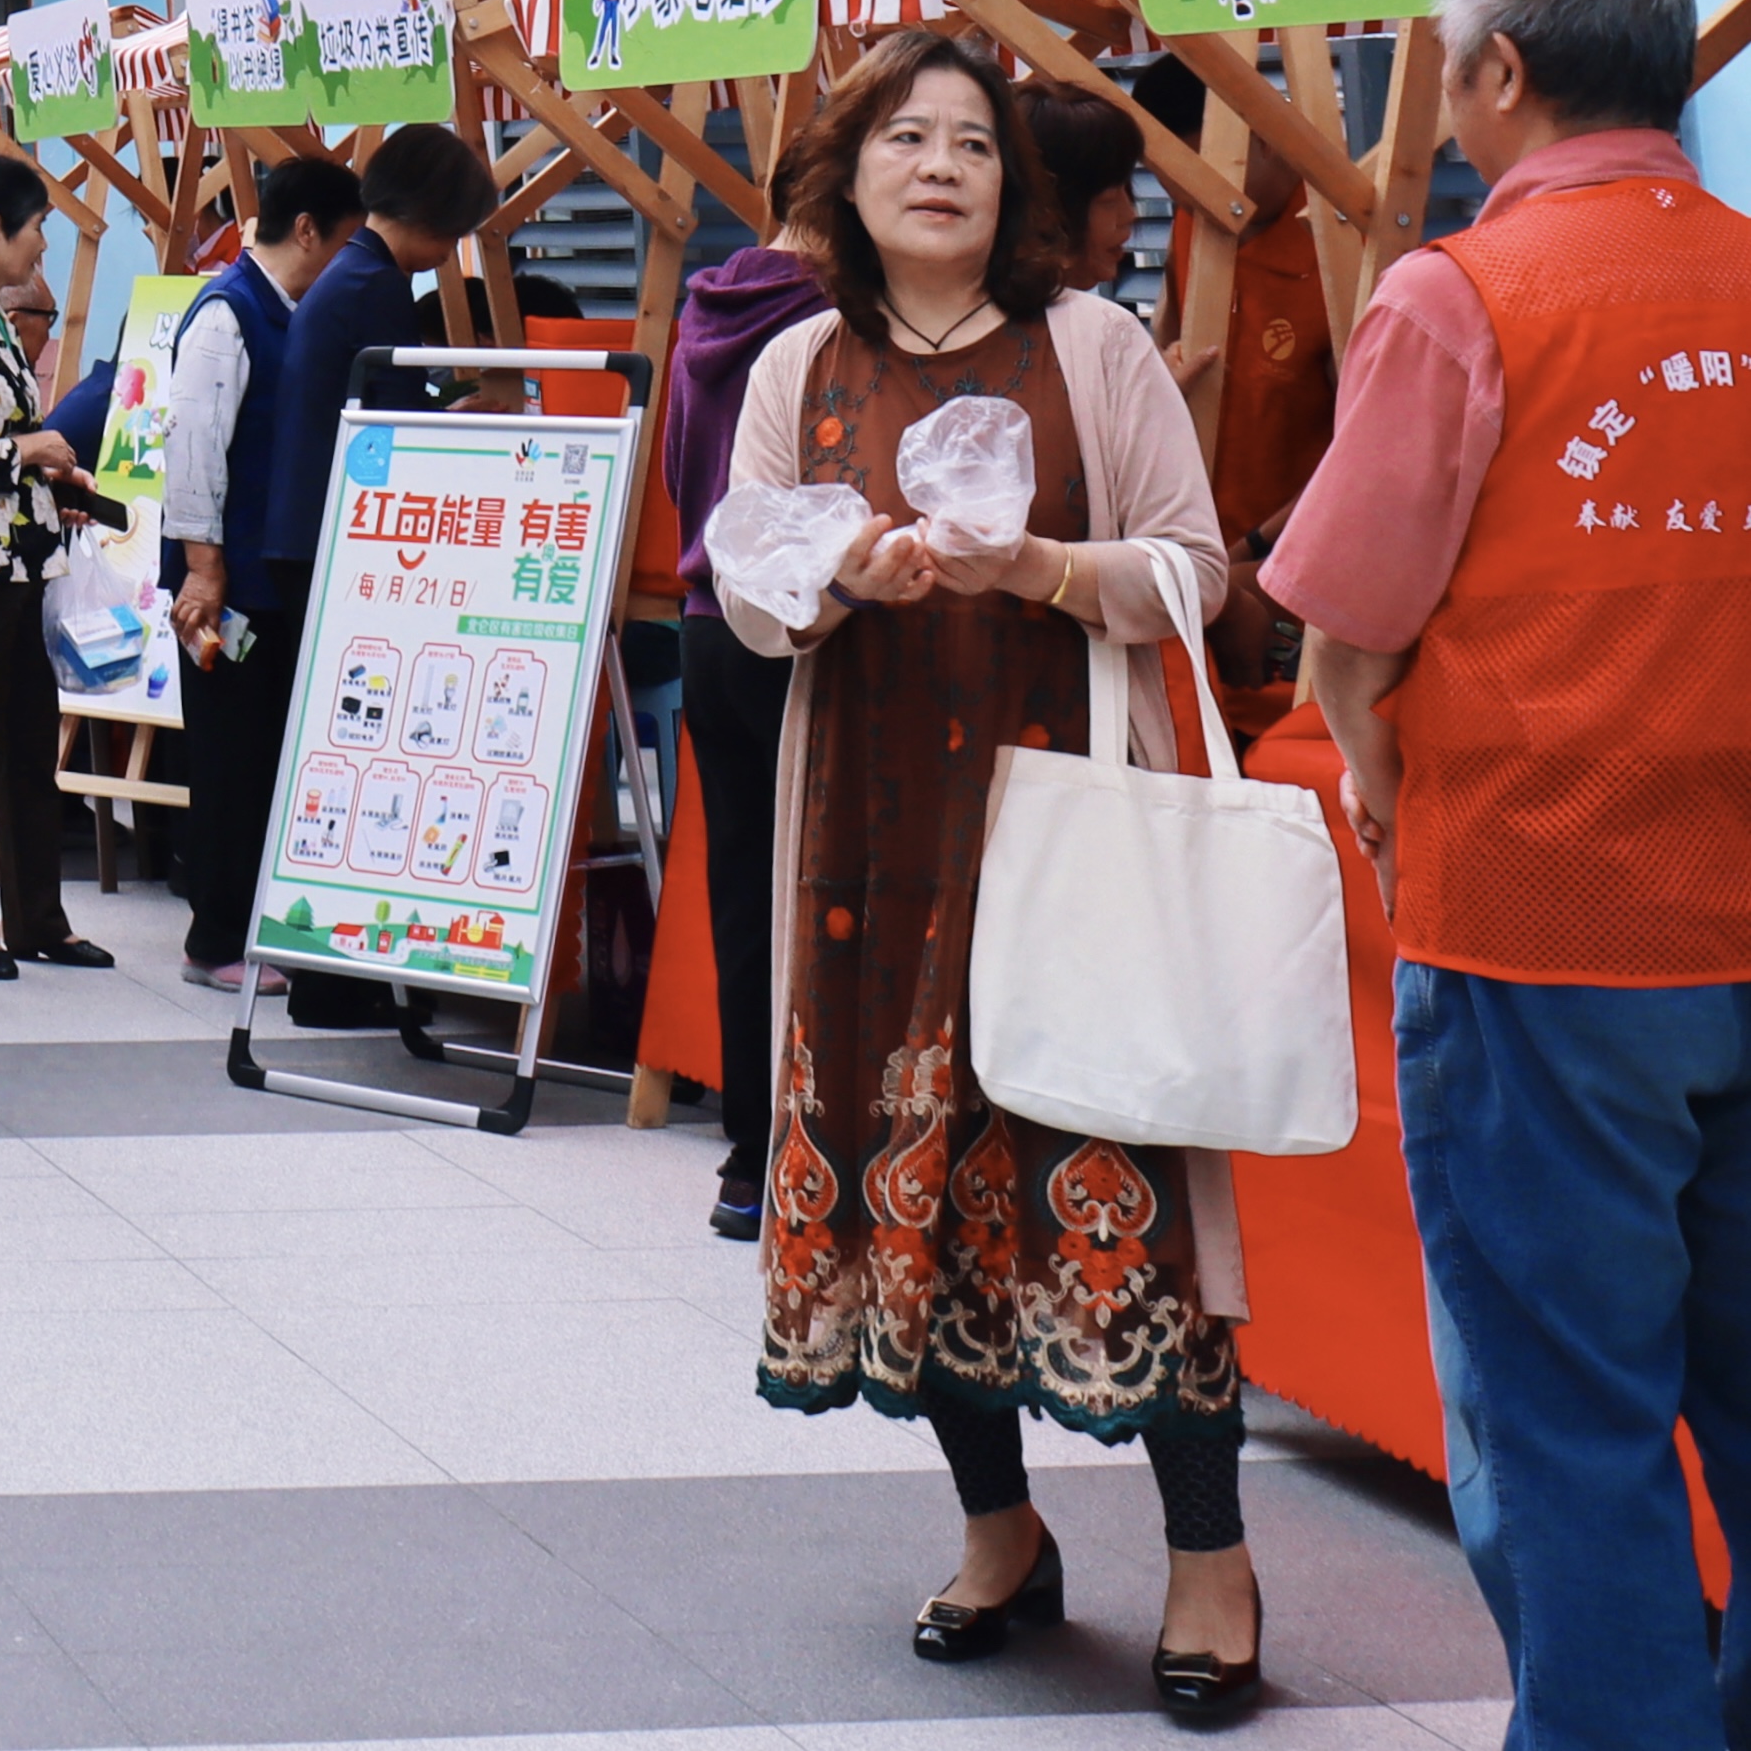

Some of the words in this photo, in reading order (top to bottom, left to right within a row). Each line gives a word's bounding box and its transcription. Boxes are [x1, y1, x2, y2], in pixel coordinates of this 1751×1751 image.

[320, 13, 432, 66] 垃圾分类宣传
[347, 489, 506, 548] 红色能量
[519, 498, 592, 552] 有害
[1574, 498, 1641, 535] 奉献
[1665, 498, 1723, 534] 友爱
[511, 551, 582, 605] 有爱
